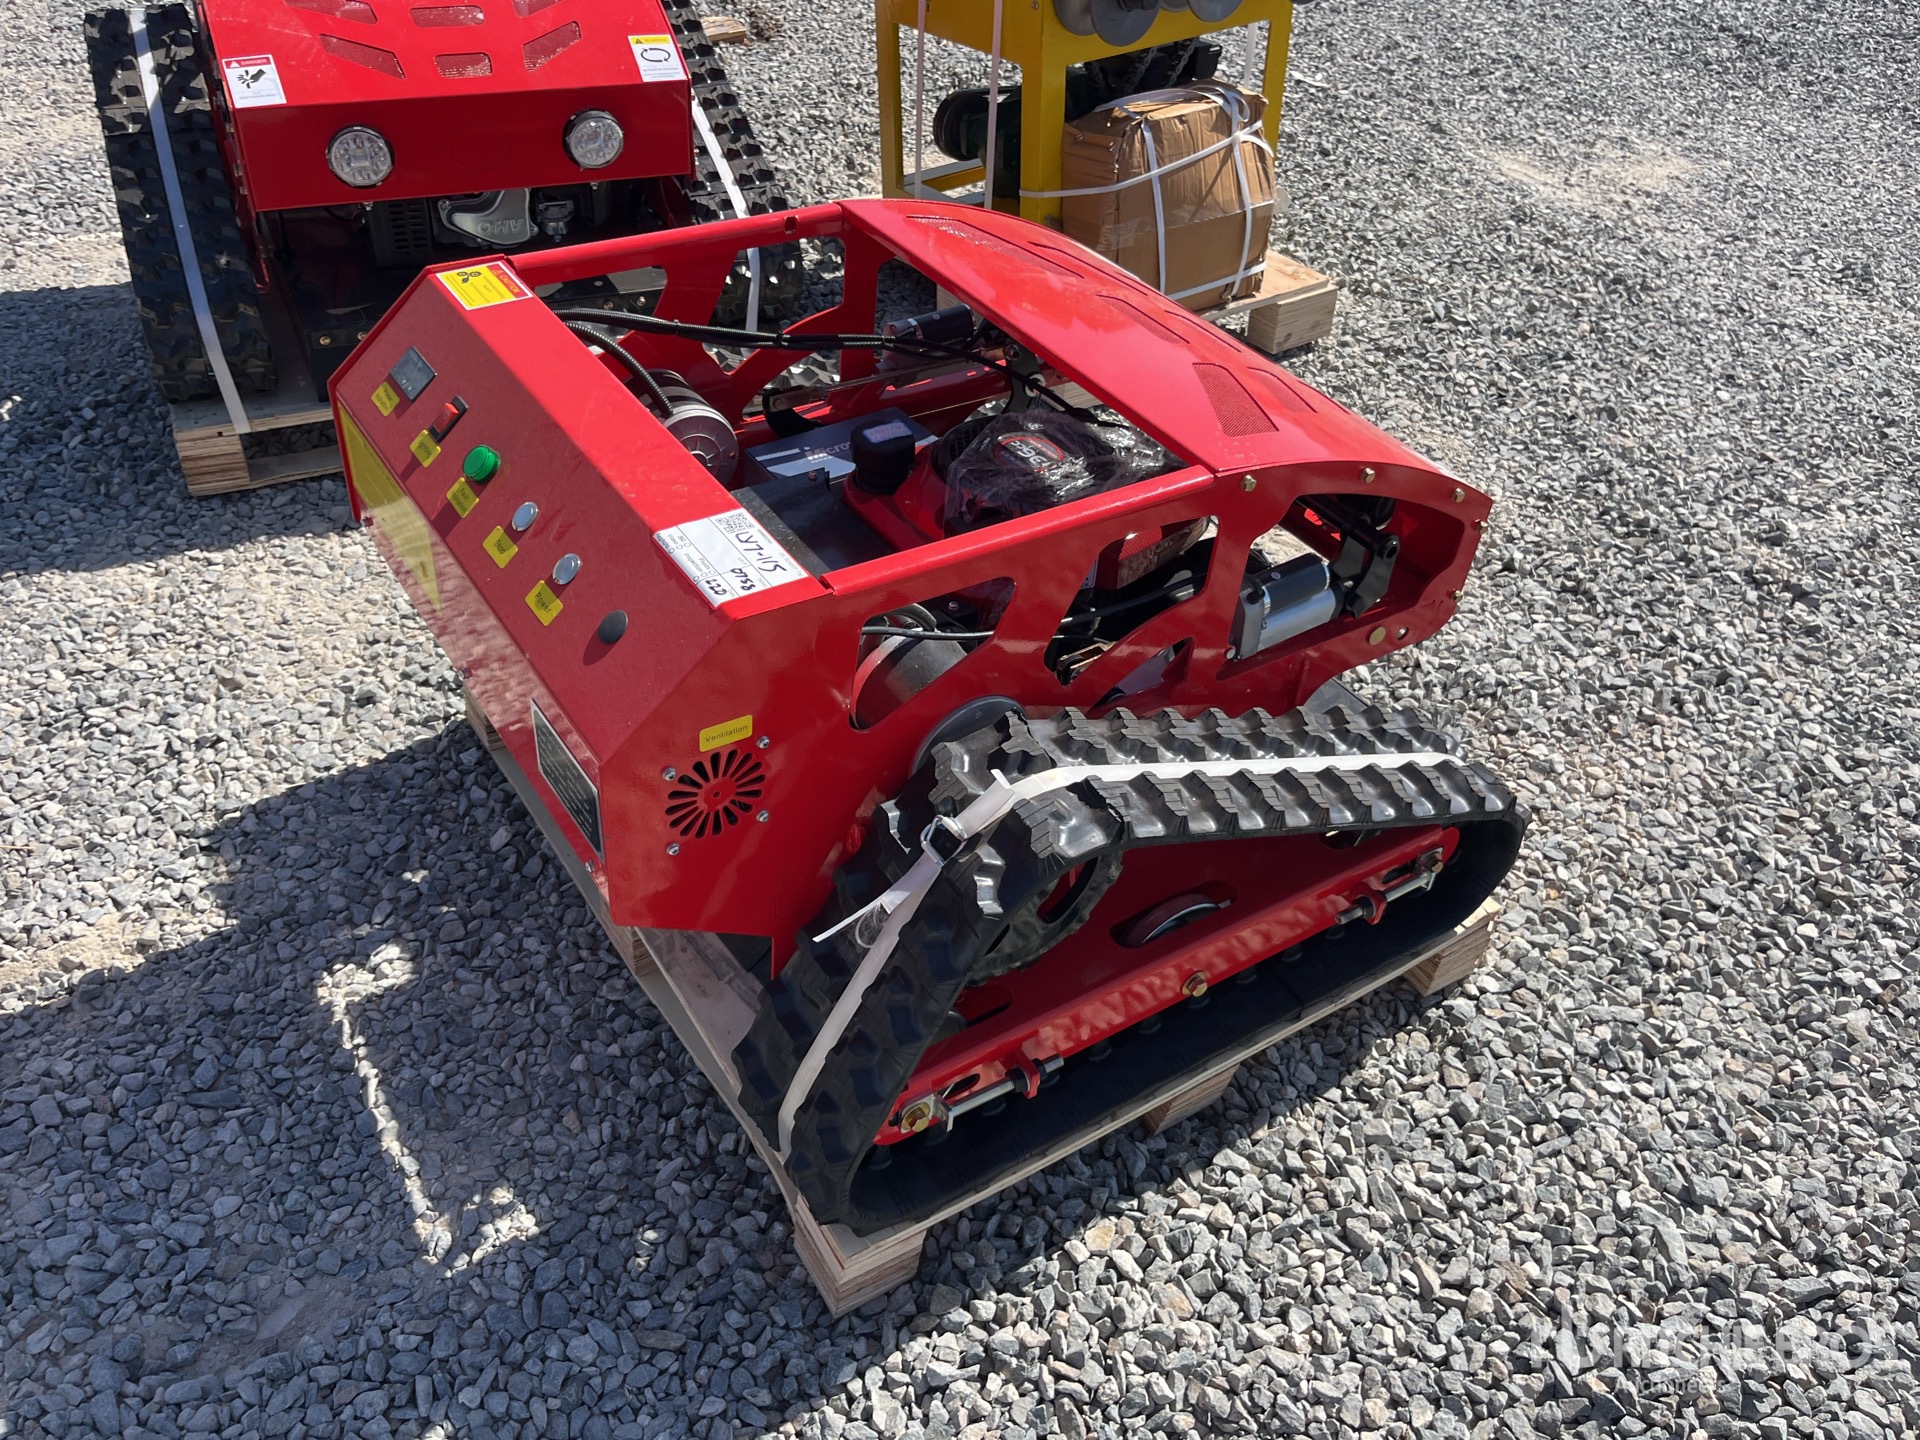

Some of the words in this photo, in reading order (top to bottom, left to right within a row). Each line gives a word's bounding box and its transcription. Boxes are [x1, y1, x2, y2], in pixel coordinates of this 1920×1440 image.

[500, 273, 521, 294] CAUTION
[493, 539, 506, 555] Stop
[684, 552, 703, 573] Inspection
[535, 591, 552, 613] Power
[705, 725, 748, 743] Ventilation
